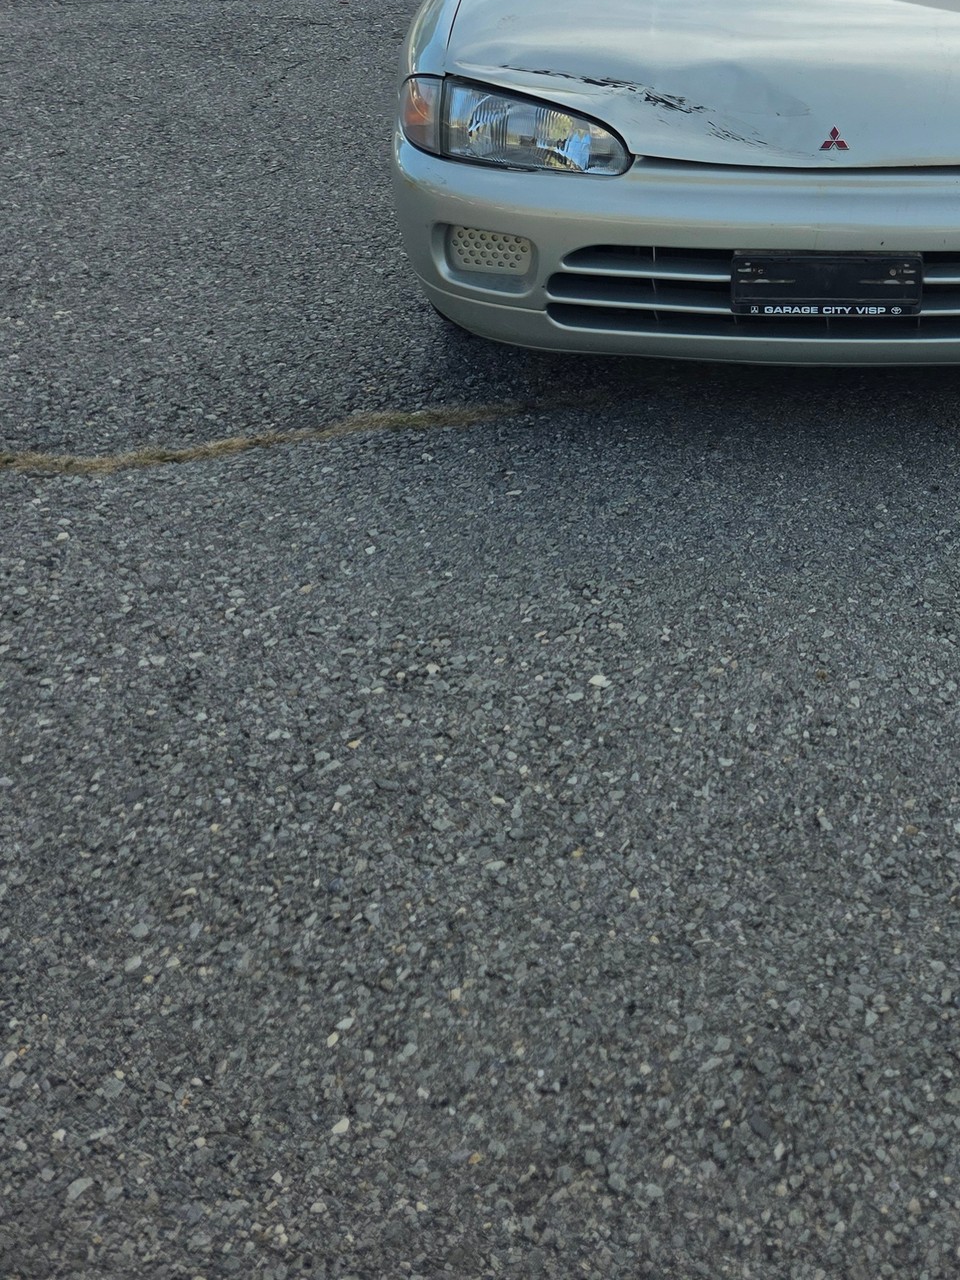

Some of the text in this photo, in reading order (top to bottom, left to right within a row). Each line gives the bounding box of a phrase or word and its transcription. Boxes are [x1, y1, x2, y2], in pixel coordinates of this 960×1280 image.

[764, 306, 887, 314] GARAGE CITY VISP
